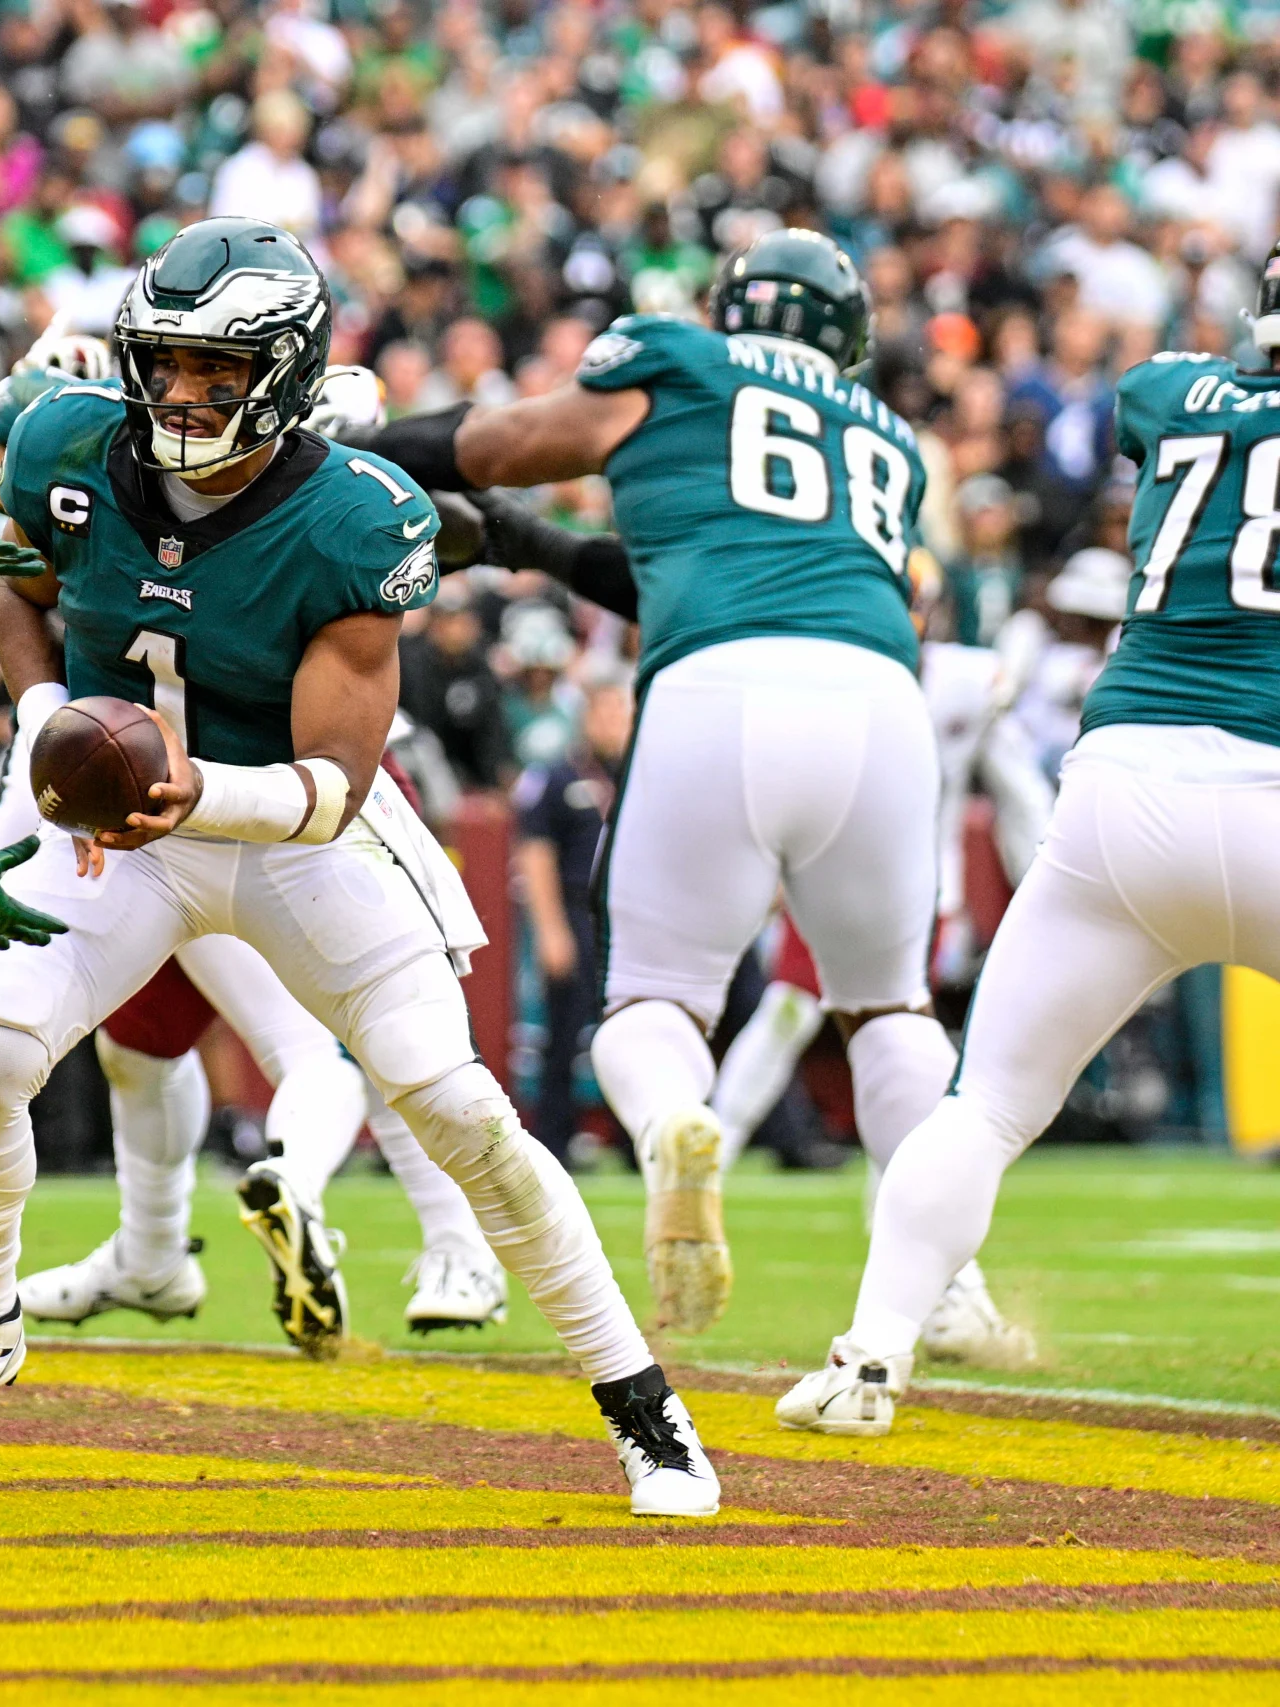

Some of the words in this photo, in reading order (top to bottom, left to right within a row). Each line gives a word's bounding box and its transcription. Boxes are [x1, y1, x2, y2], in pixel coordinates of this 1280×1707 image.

[346, 456, 416, 507] 1
[729, 384, 911, 576] 68
[49, 486, 90, 526] C
[160, 549, 179, 564] NFL
[139, 580, 194, 611] EAGLES
[123, 628, 188, 758] 1
